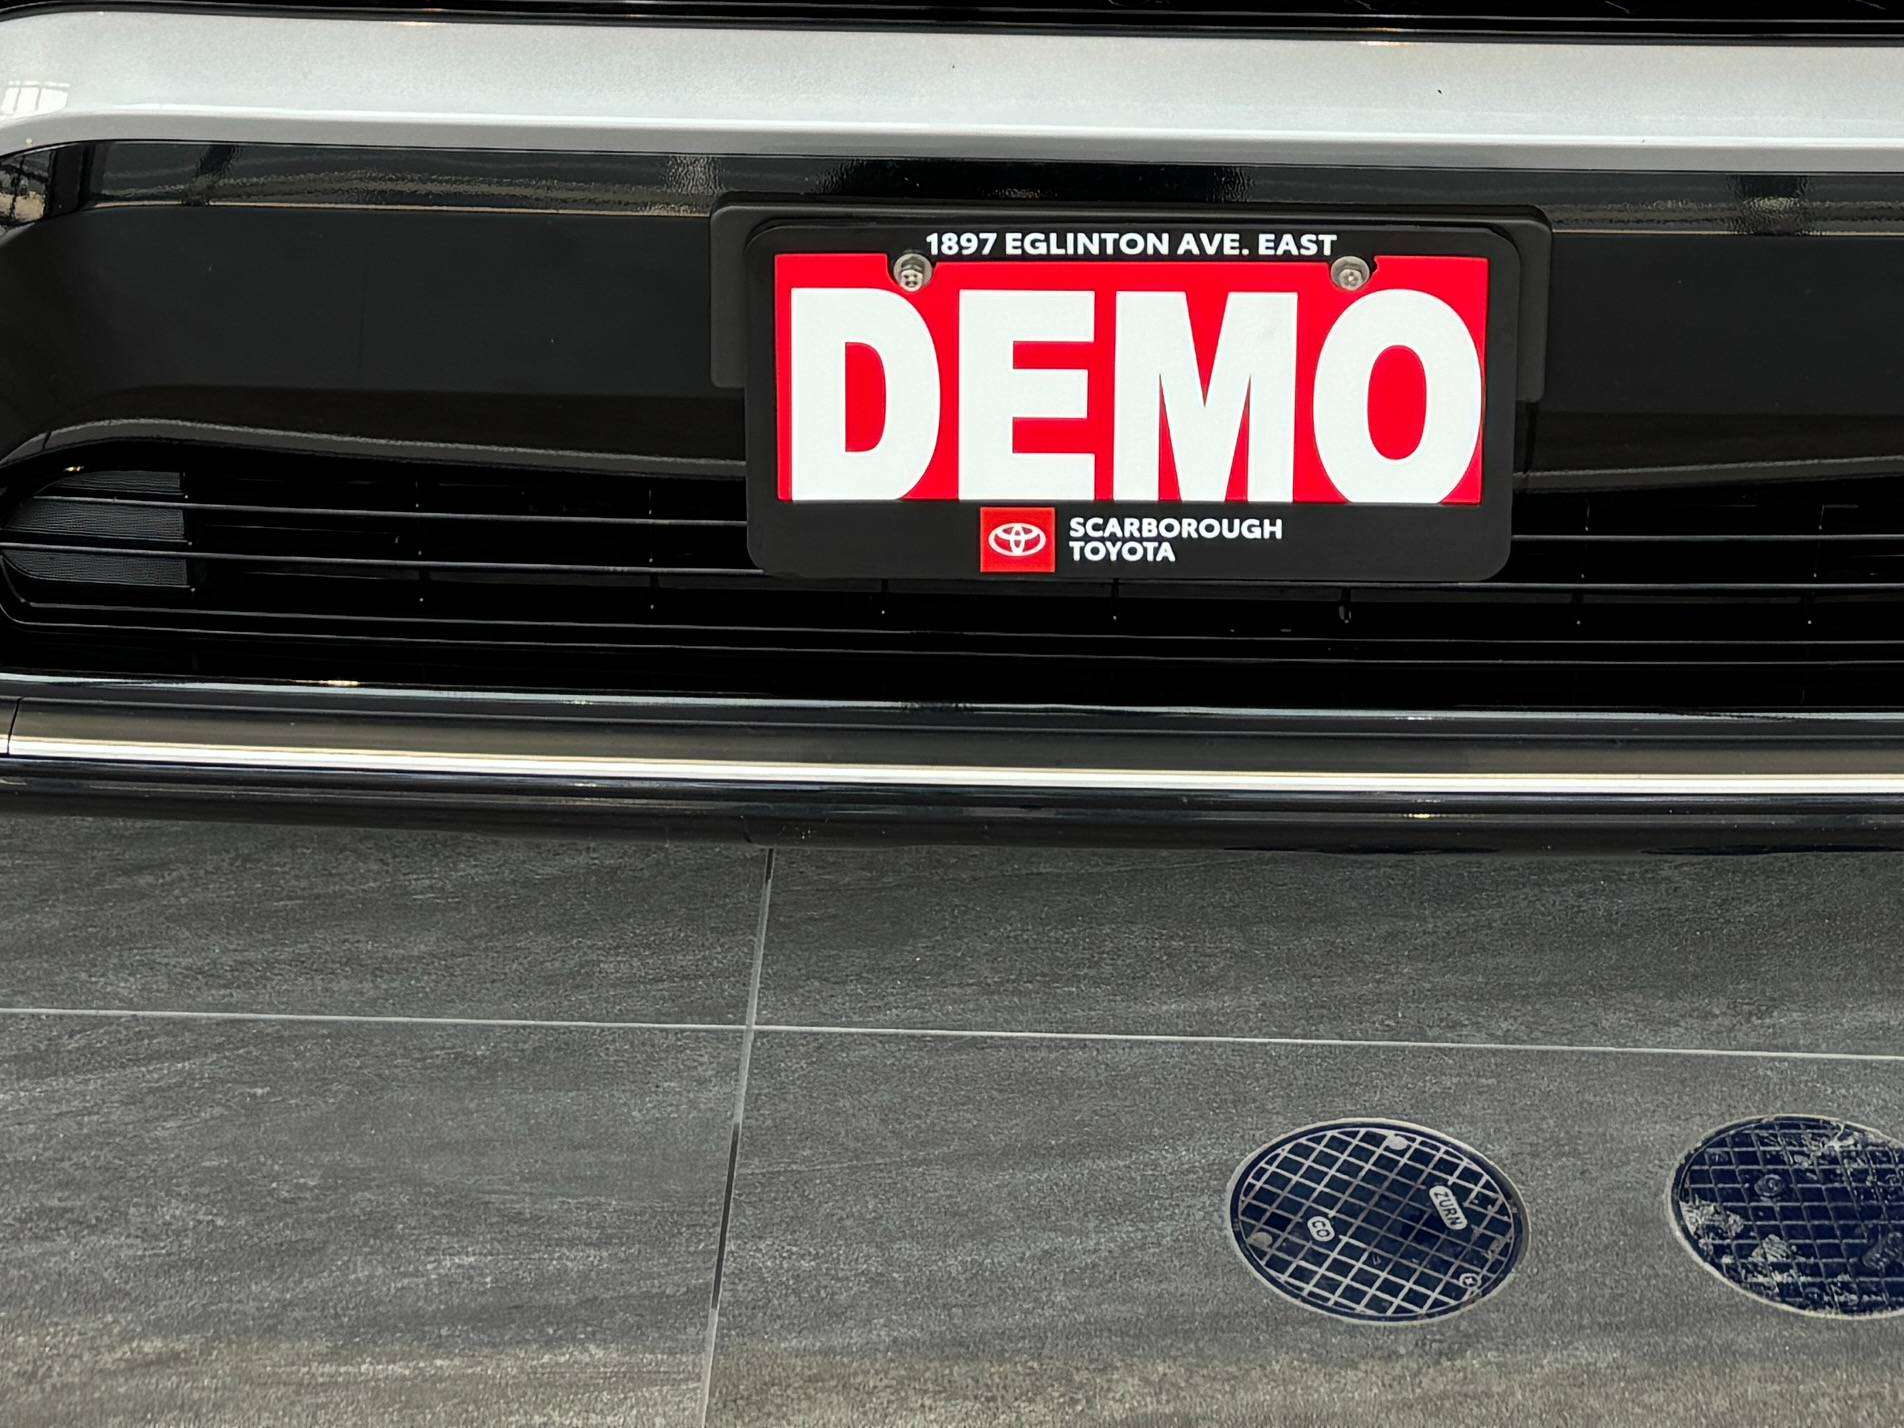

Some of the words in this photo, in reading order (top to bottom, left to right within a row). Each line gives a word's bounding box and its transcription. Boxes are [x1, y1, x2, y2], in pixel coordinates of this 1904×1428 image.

[926, 232, 996, 256] 1897
[1006, 232, 1169, 256] EGLINTON
[1177, 233, 1250, 256] AVE.
[1257, 233, 1337, 257] EAST
[790, 288, 1483, 504] DEMO
[1069, 517, 1283, 540] SCARBOROUGH
[1069, 541, 1176, 563] TOYOTA
